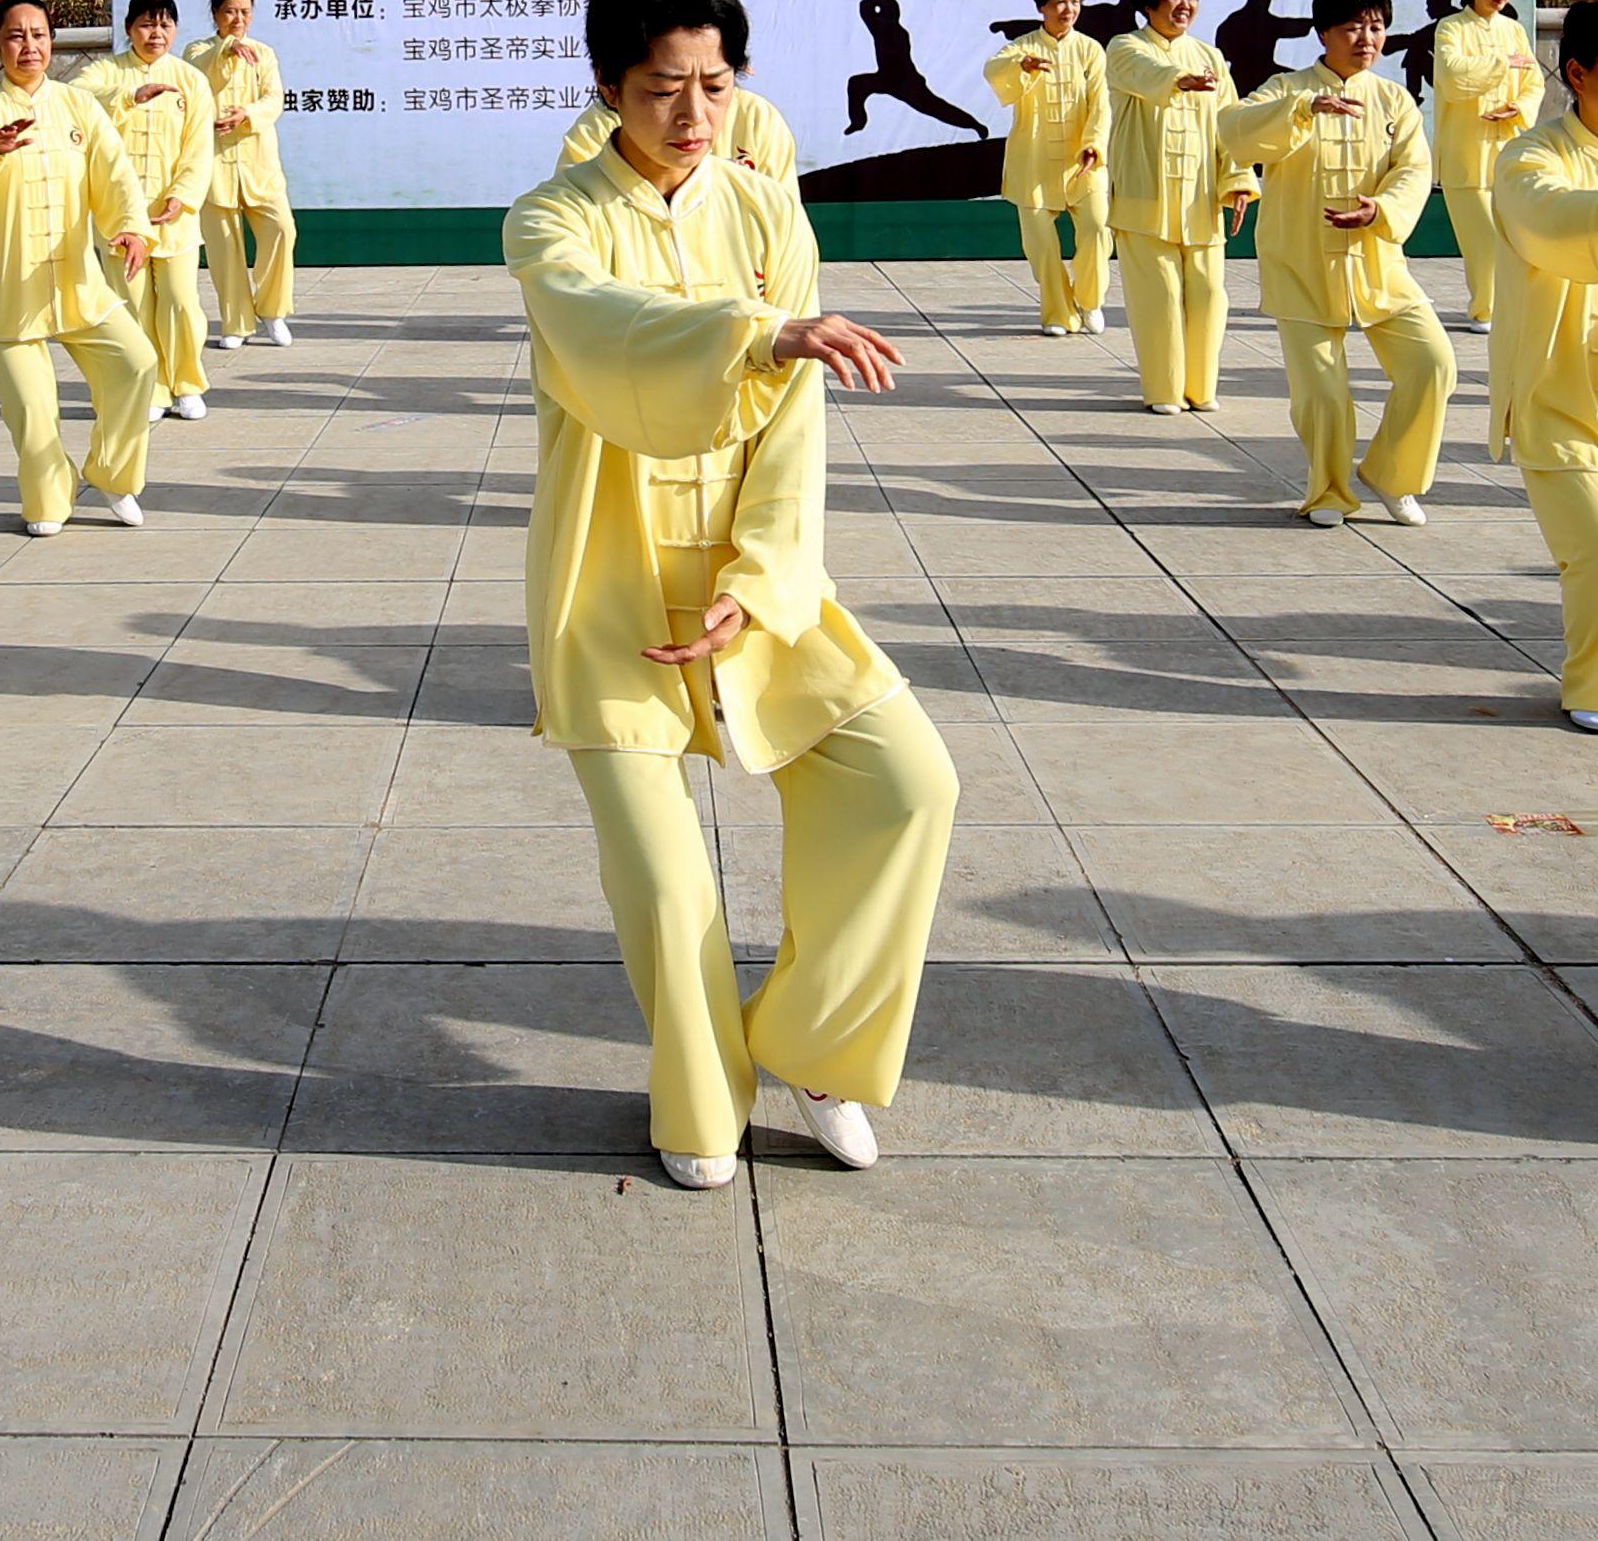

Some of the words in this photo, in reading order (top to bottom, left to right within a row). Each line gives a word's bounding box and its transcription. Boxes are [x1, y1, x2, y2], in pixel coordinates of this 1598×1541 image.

[403, 36, 591, 62] 宝鸡市圣帝实业
